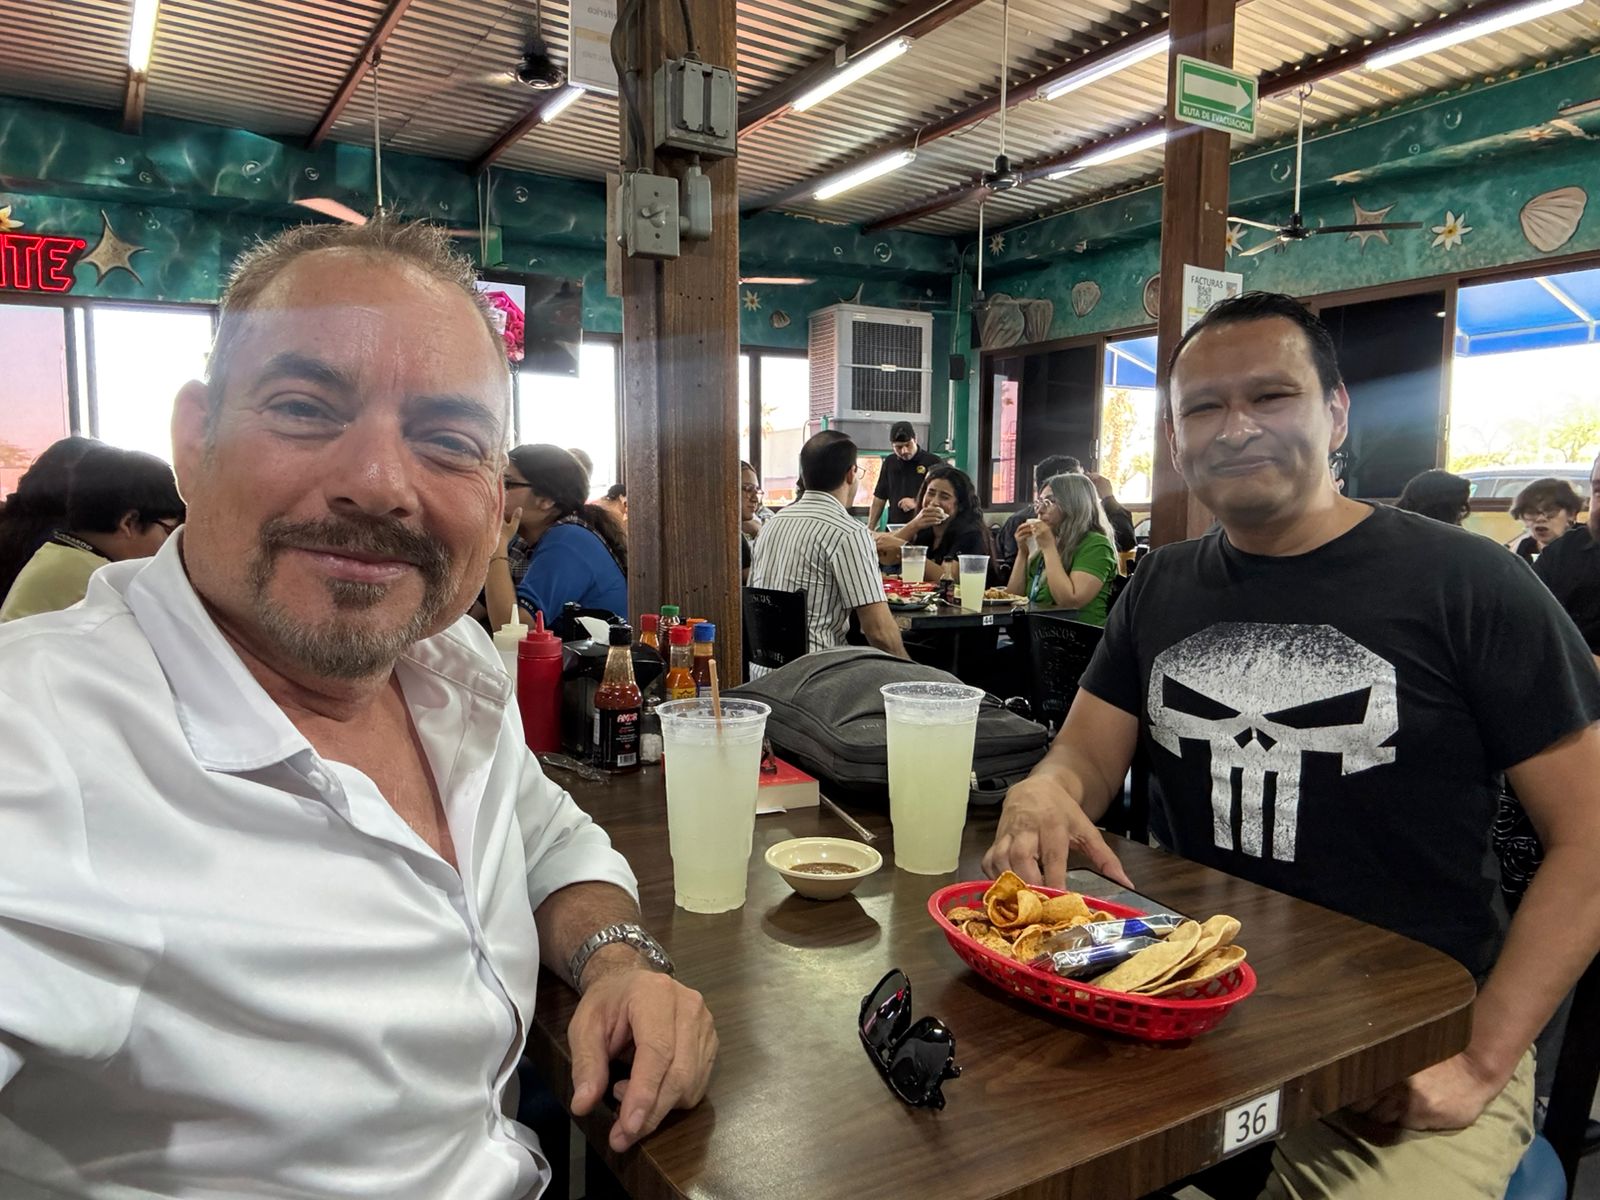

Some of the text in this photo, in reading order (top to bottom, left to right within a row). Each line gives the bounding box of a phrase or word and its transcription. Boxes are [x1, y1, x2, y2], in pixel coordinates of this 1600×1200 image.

[1183, 105, 1200, 117] RUTA
[1201, 111, 1210, 120] DE
[1191, 275, 1224, 288] FACTURAS
[1236, 1103, 1267, 1143] 36
